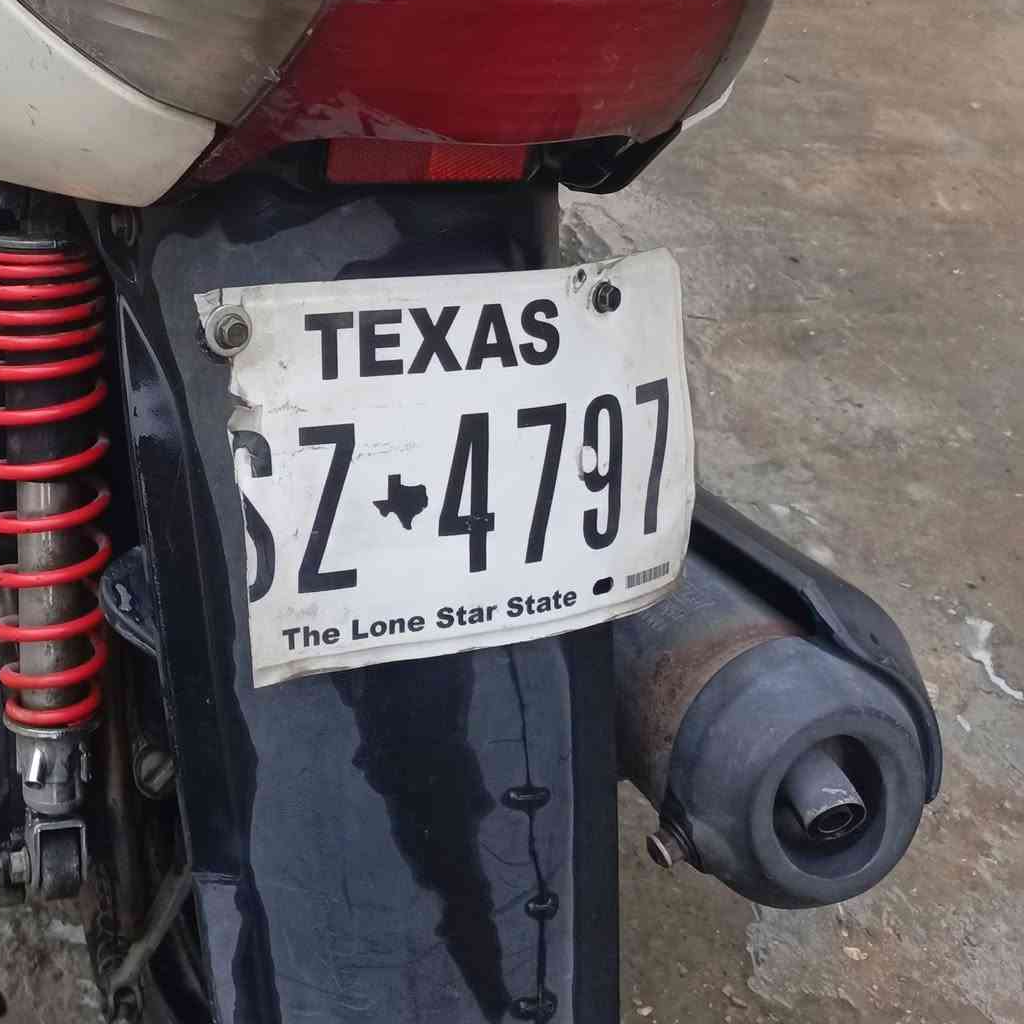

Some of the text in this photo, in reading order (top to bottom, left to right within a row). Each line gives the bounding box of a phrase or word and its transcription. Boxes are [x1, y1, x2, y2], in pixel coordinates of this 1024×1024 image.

[304, 298, 560, 381] TEXAS
[438, 377, 670, 573] 4797
[282, 589, 577, 651] The Lone Star State
